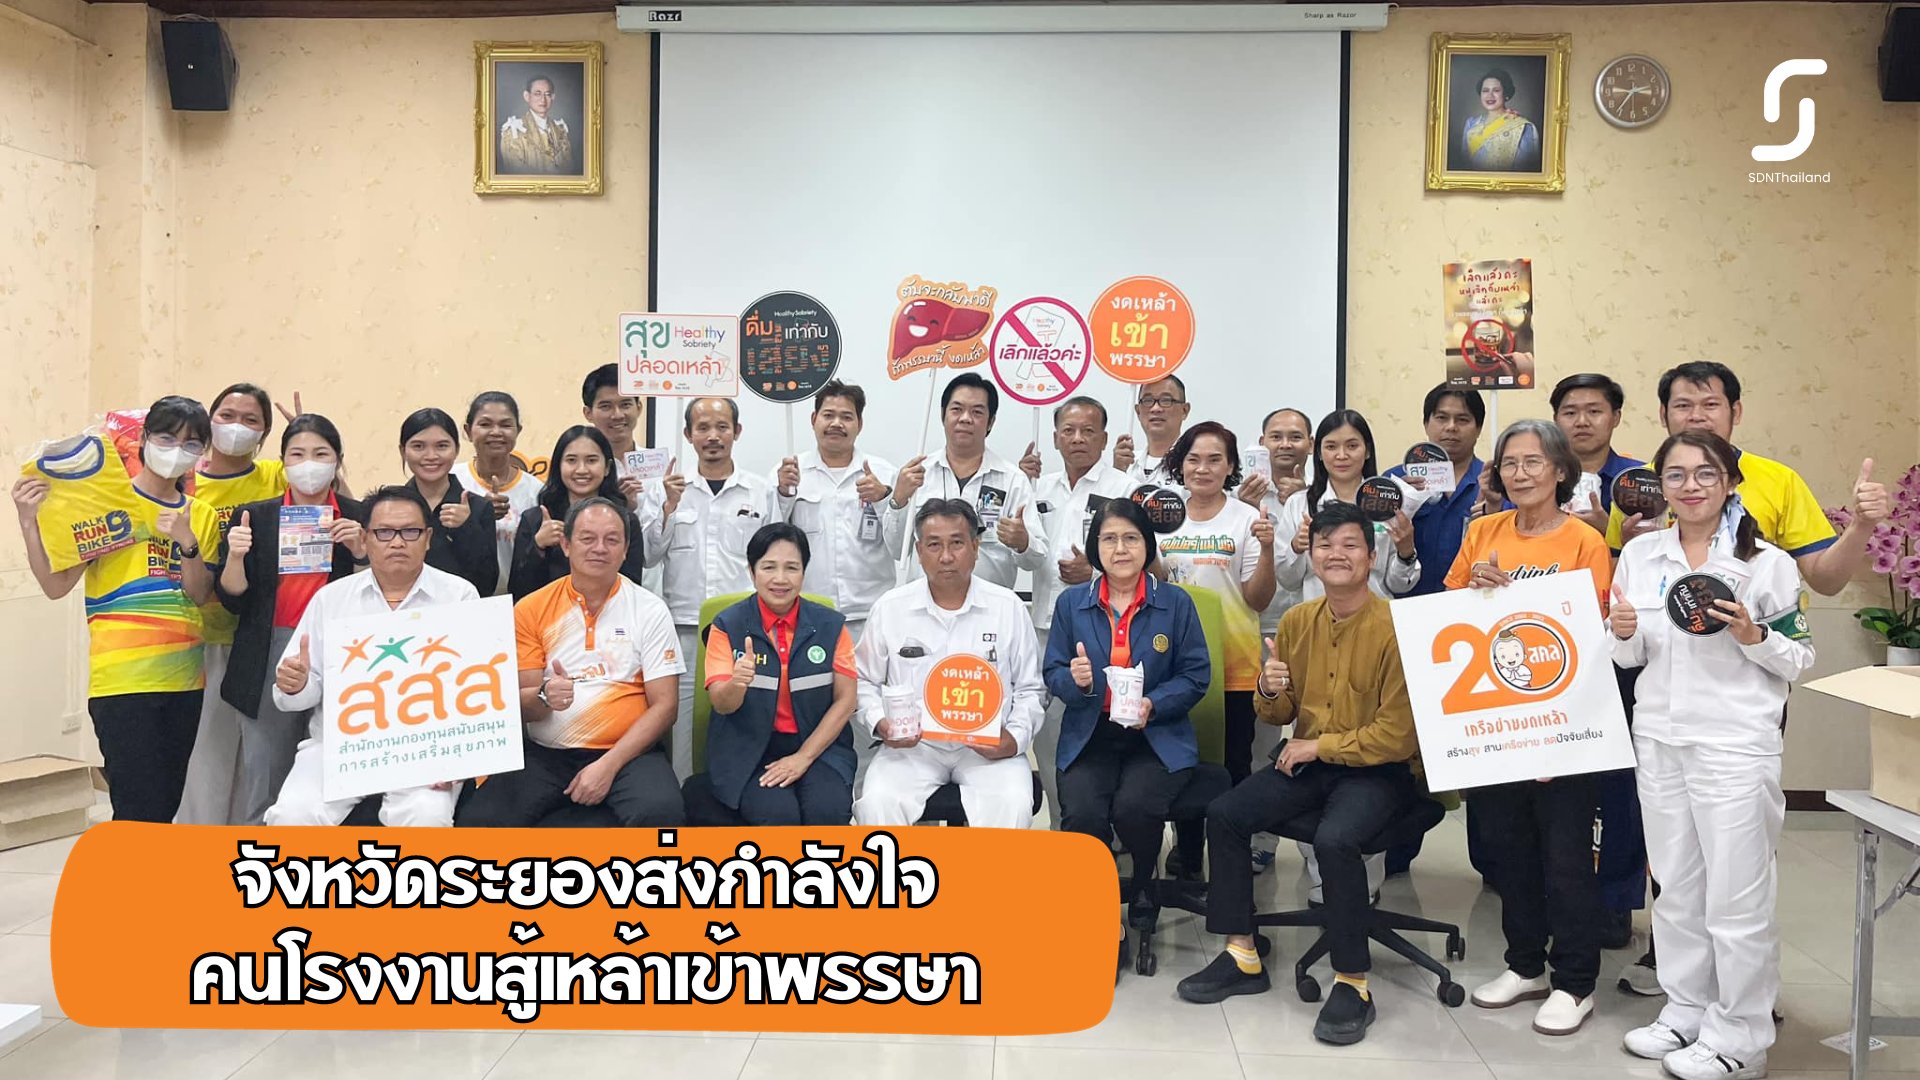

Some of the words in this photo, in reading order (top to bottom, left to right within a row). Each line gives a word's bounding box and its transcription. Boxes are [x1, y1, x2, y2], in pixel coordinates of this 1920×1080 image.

[649, 11, 680, 21] Razr
[901, 280, 993, 307] ตับจะกลับมาดี
[1110, 291, 1176, 312] งดเหล้า
[745, 309, 774, 337] ดื่ม
[785, 322, 828, 340] เท่ากับ
[1110, 312, 1169, 349] เข้า
[625, 320, 670, 358] สุข
[674, 325, 726, 343] Healthy
[682, 339, 717, 350] Sobriety
[892, 345, 951, 375] ถ้าพรรษานี้
[948, 342, 985, 364] งดเหล้า
[999, 343, 1082, 361] เลิกแล้วค่ะ
[1109, 352, 1167, 369] พรรษา
[626, 354, 721, 375] ปลอดเหล้า
[71, 516, 104, 531] WALK
[74, 524, 109, 543] RUN
[105, 510, 132, 541] 9
[77, 535, 111, 553] BIKE
[1560, 600, 1573, 616] ปี
[1431, 611, 1579, 715] 20
[1528, 644, 1561, 664] สคล
[941, 665, 990, 681] งดเหล้า
[338, 652, 508, 736] สสส
[941, 680, 985, 708] เข้า
[941, 708, 983, 722] พรรษา
[1464, 709, 1568, 738] เครือข่ายงดเหล้า
[339, 719, 506, 755] สำนักงานกองทุนสนับสนุน
[1446, 745, 1481, 758] สร้างสุข
[1484, 738, 1540, 753] สานเครือข่าย
[1543, 727, 1604, 746] ลดปัจจัยเสี่ยง
[339, 736, 508, 773] การสร้างเสริมสุขภาพ
